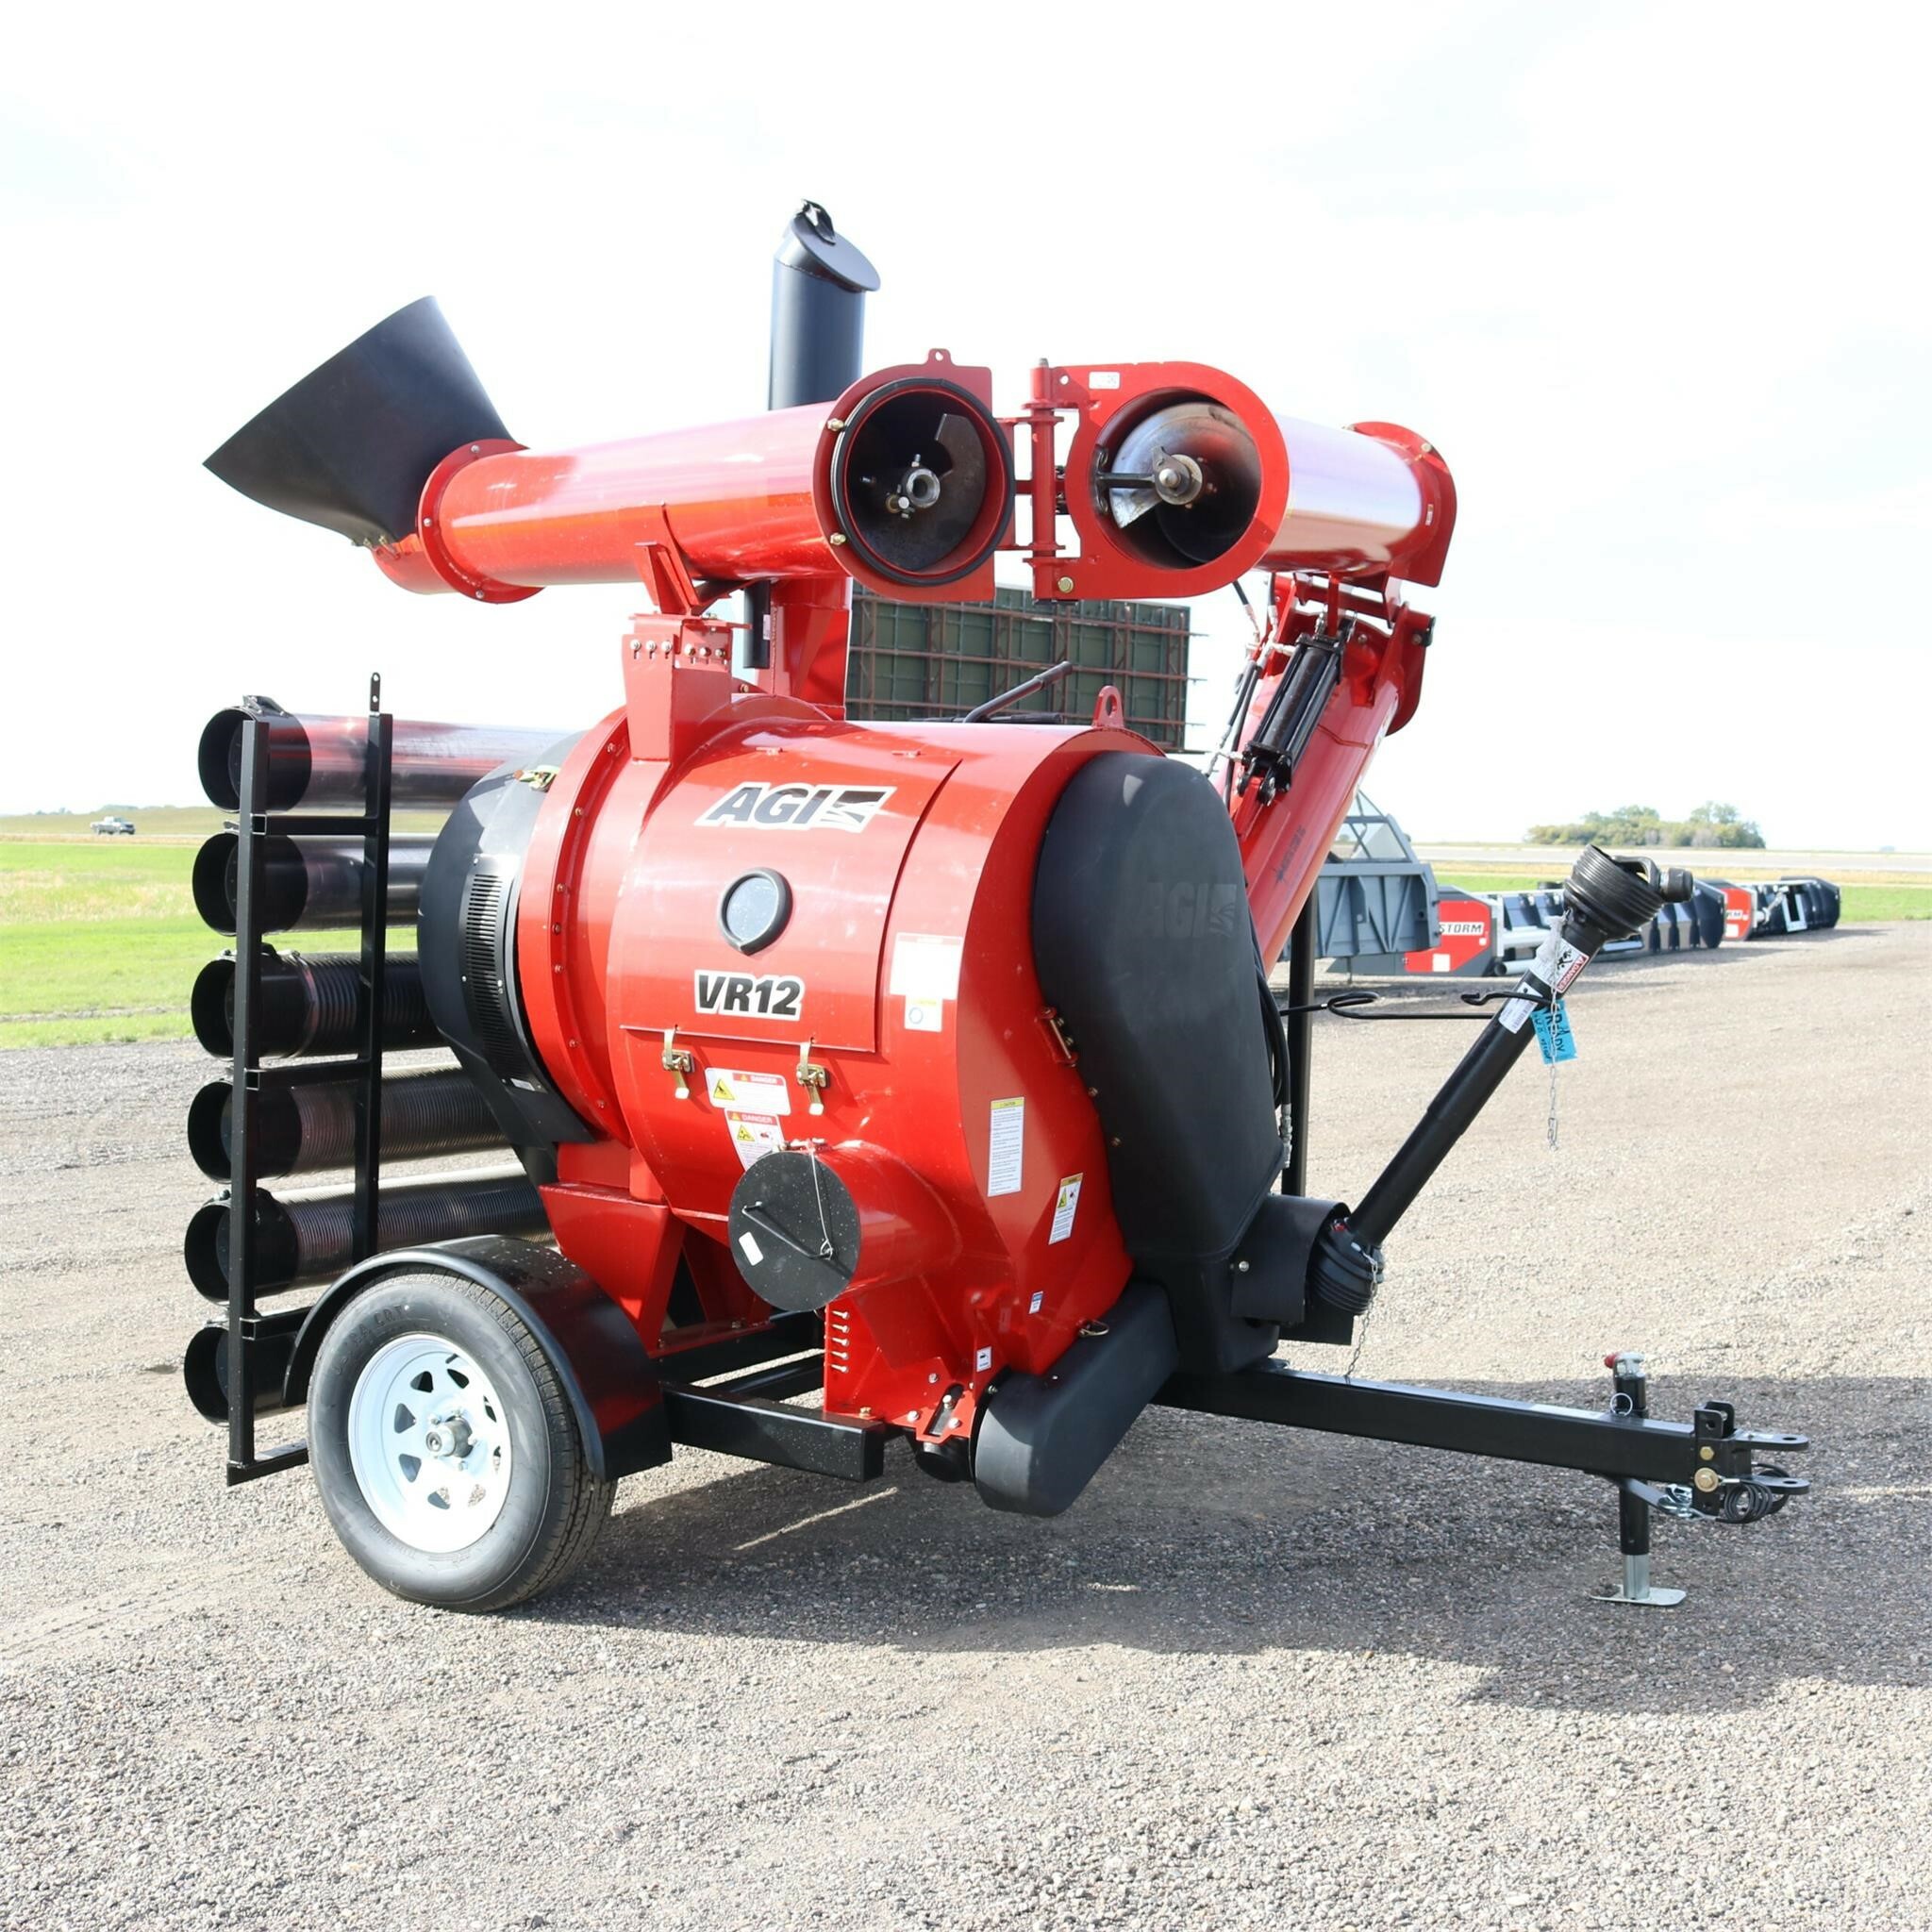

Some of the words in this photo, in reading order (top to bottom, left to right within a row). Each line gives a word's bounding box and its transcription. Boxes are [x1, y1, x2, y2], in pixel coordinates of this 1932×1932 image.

[706, 787, 833, 824] AGI
[1133, 881, 1209, 939] AGI
[698, 974, 801, 1016] VR12
[741, 1113, 773, 1124] DANGER
